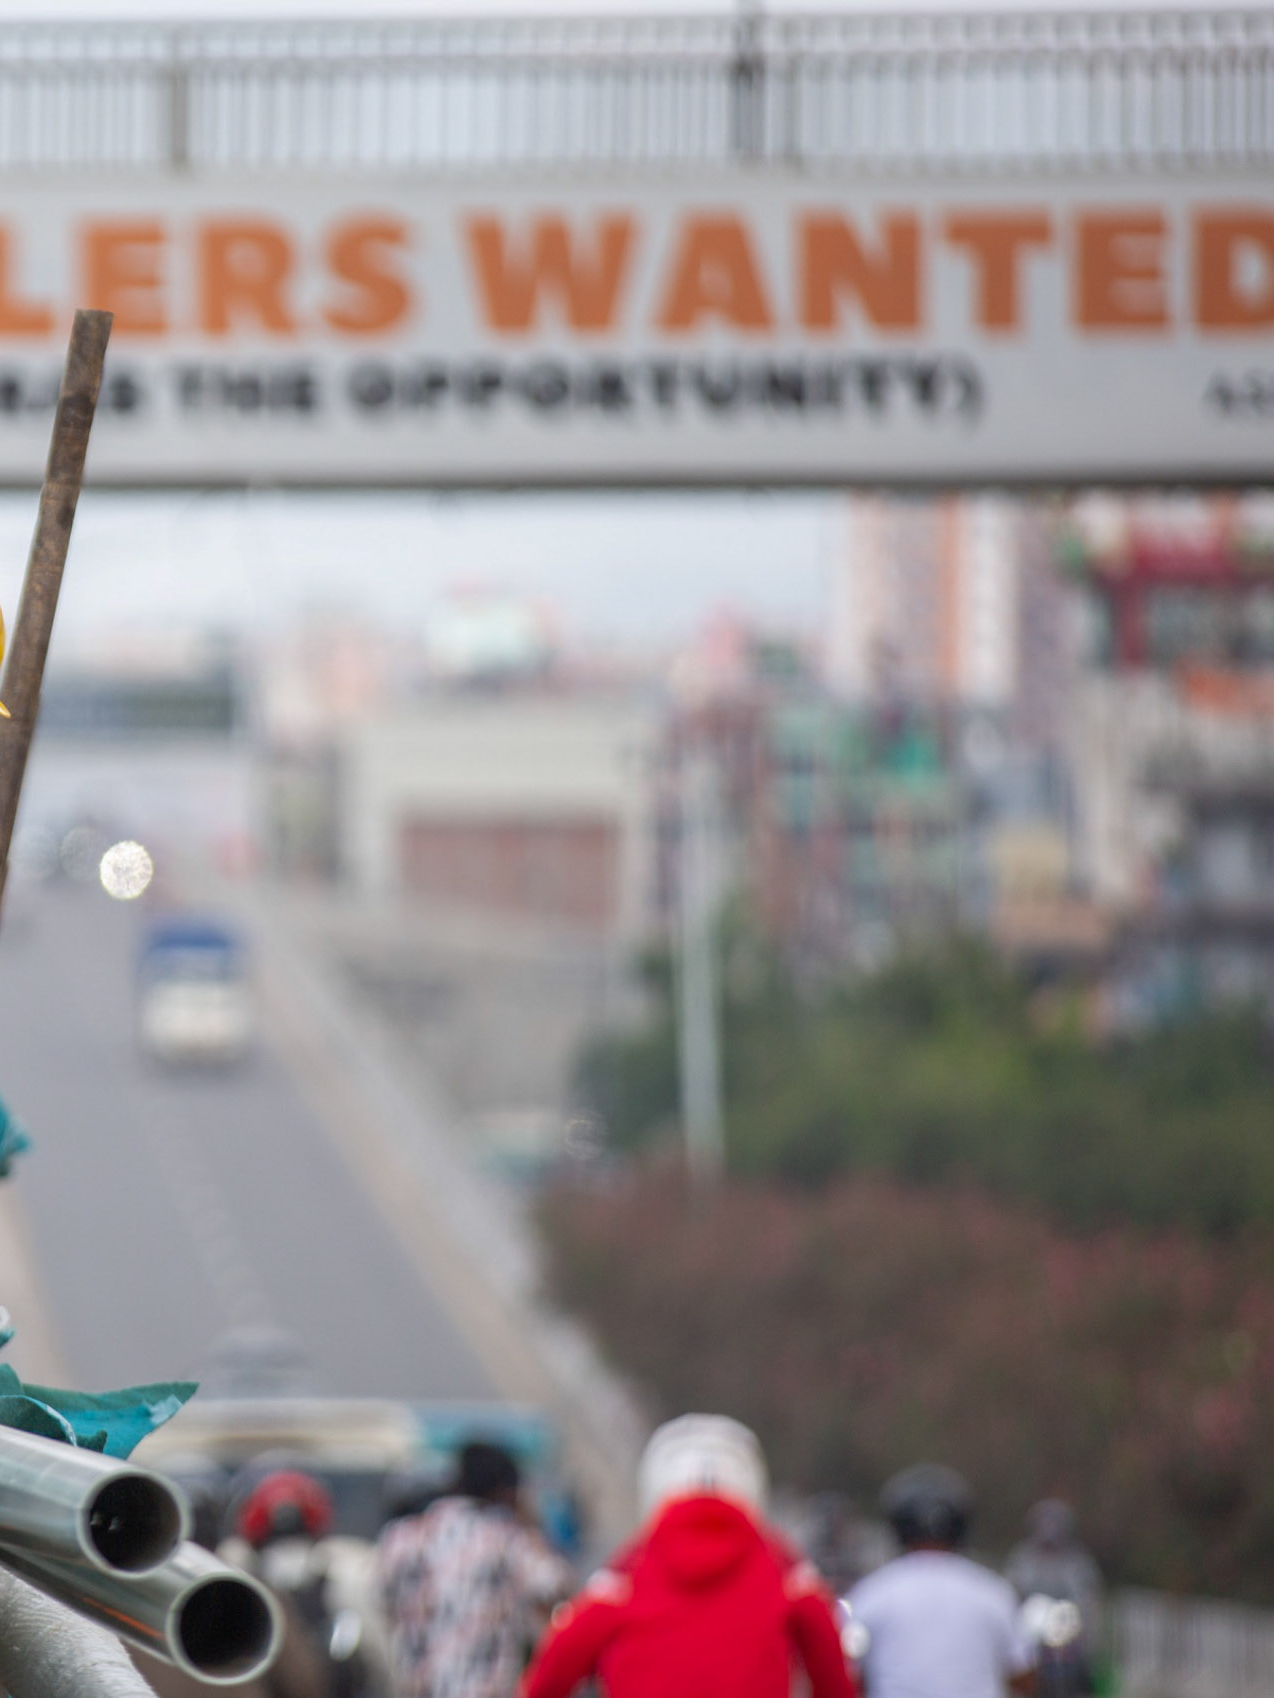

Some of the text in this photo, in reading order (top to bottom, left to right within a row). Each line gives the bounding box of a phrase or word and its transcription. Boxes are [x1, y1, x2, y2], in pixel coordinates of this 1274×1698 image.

[460, 208, 1274, 340] WANTED
[172, 355, 324, 420] THE
[346, 350, 982, 430] OPPORTUNITY)
